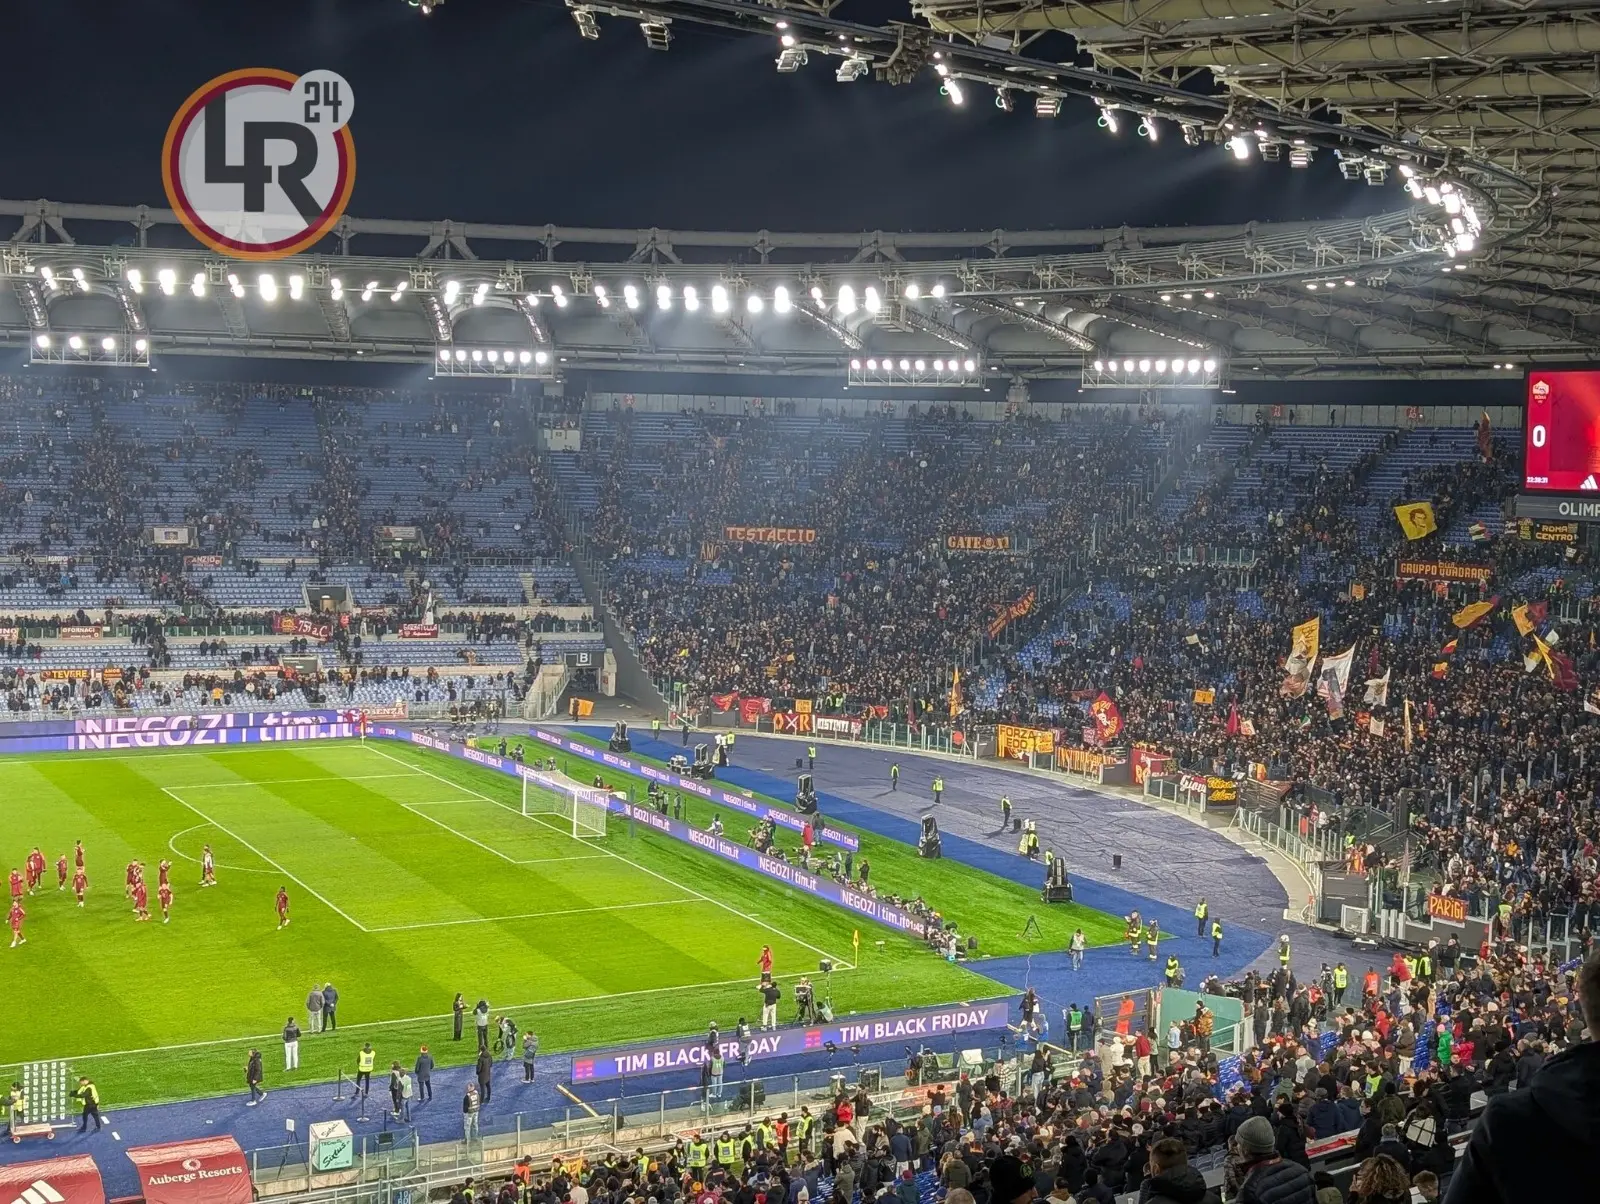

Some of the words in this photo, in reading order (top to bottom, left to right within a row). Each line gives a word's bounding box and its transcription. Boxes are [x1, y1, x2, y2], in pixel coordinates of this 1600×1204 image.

[1532, 425, 1546, 447] 0
[726, 526, 816, 543] TESTACCIO
[1542, 525, 1568, 533] ROMA
[948, 536, 981, 549] GATE
[1400, 563, 1437, 576] GRUPPO
[580, 653, 588, 663] B
[52, 669, 88, 679] TEVERE
[74, 714, 235, 750] NEGOZI
[411, 732, 433, 747] NEGOZI
[1000, 725, 1036, 739] FORZA
[1006, 738, 1028, 749] EDO
[463, 747, 484, 763] NEGOZI
[624, 804, 649, 822] NGOZI
[652, 815, 670, 832] tim.it
[688, 828, 715, 850] NEGOZI
[720, 842, 738, 860] tim.it
[758, 856, 790, 880] NEGOZI
[795, 871, 818, 891] tim.it
[840, 889, 876, 916] NEGOZI
[881, 907, 905, 929] tim.it
[840, 1026, 870, 1043] TIM
[874, 1017, 927, 1039] BLACK
[931, 1009, 989, 1031] FRIDAY
[614, 1053, 648, 1073] TIM
[718, 1035, 782, 1059] FRDAY
[148, 1173, 197, 1186] Auberge
[198, 1166, 243, 1179] Resorts
